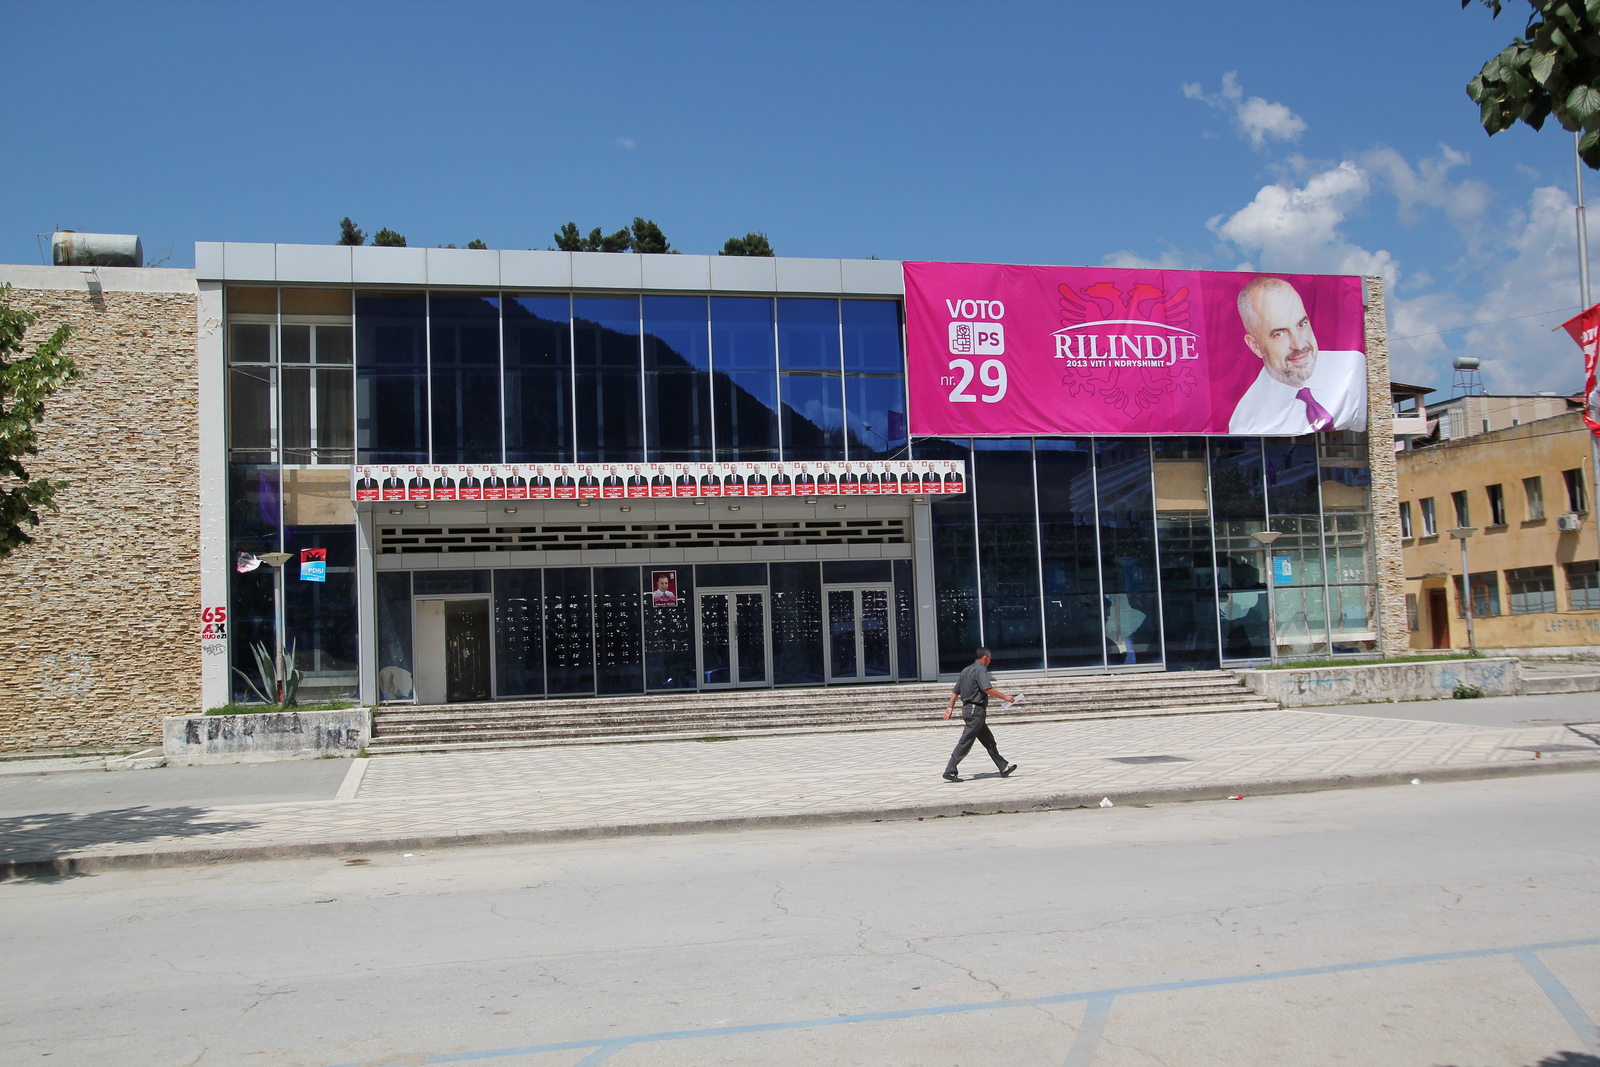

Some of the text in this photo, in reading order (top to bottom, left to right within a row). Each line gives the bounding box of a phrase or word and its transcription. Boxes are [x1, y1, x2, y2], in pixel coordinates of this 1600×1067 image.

[945, 299, 1005, 320] VOTO
[978, 331, 1000, 347] PS
[1053, 333, 1199, 366] RILINDJE
[1066, 360, 1089, 368] 2013
[1090, 360, 1107, 368] VITI
[1114, 360, 1165, 368] NDRYSHIMIT
[940, 358, 1008, 403] nr. 29
[202, 607, 226, 622] 65
